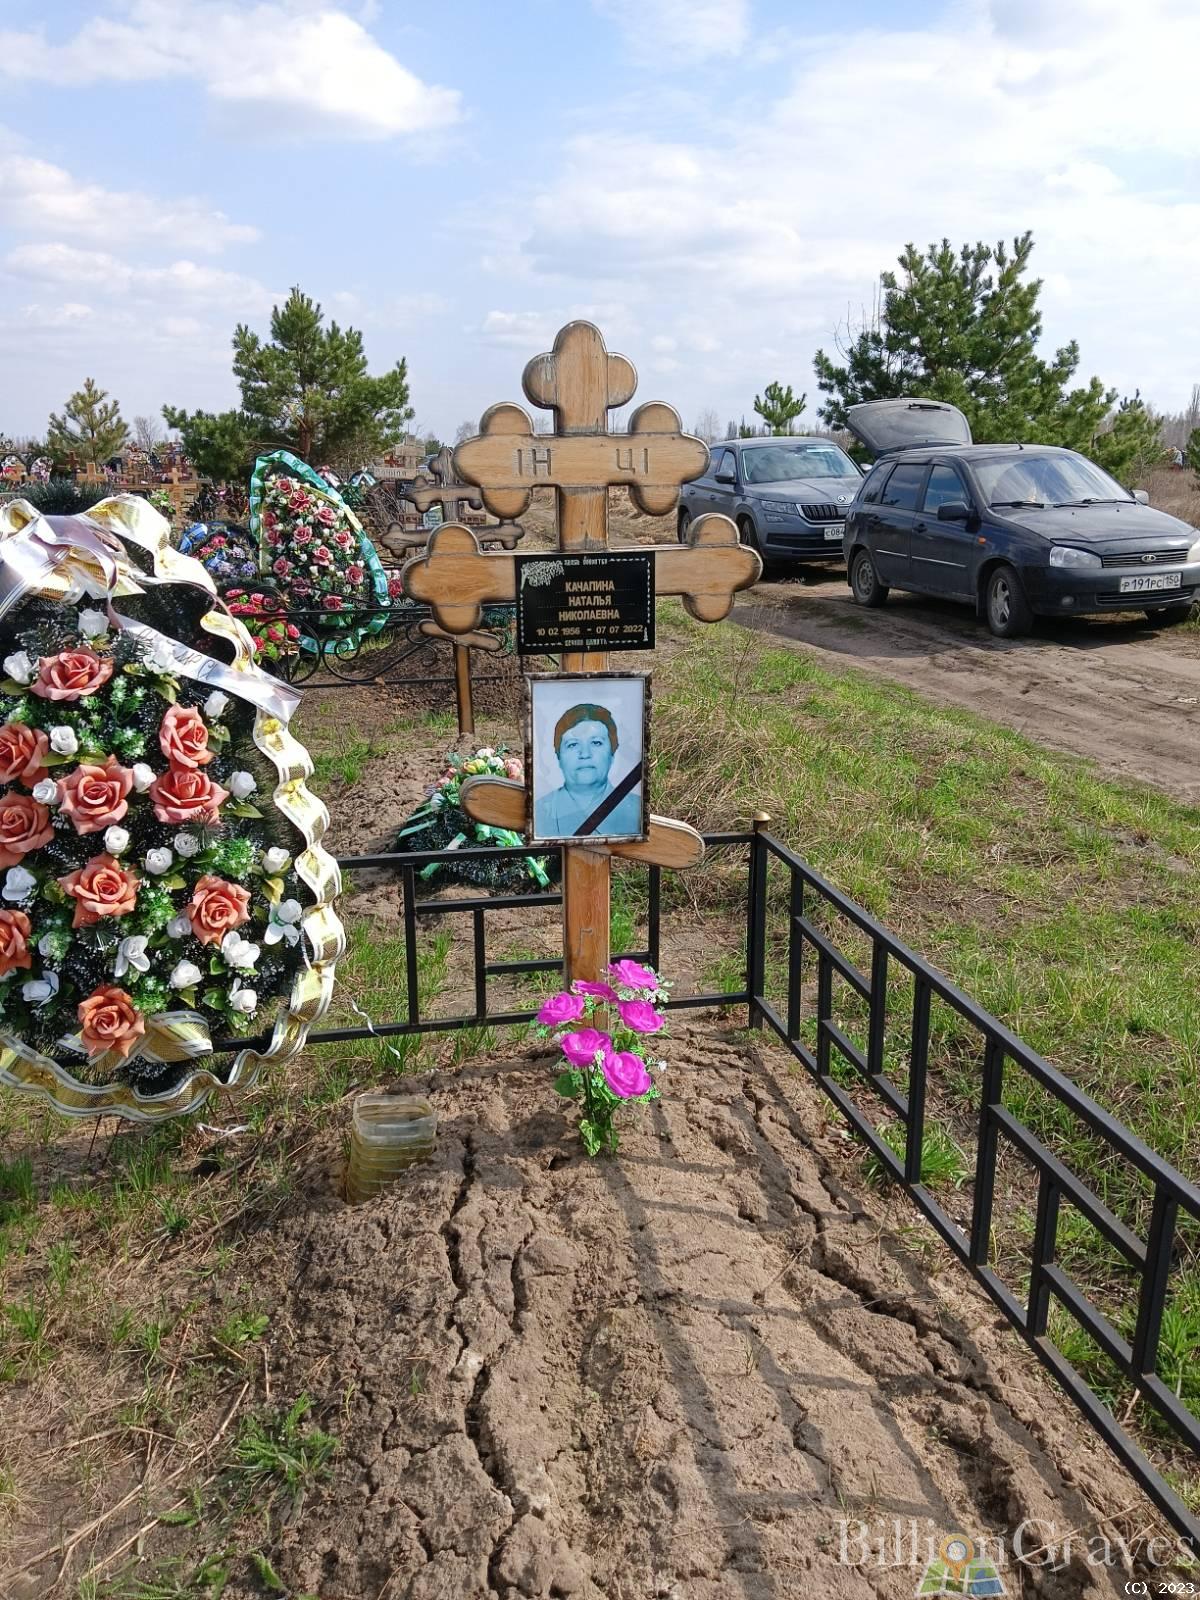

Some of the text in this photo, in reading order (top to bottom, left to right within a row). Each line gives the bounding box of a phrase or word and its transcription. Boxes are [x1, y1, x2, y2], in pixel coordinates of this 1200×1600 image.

[568, 595, 612, 606] НАТАЛЬЯ
[558, 609, 620, 621] НИКОЛАЕВНА
[623, 625, 644, 633] 2022
